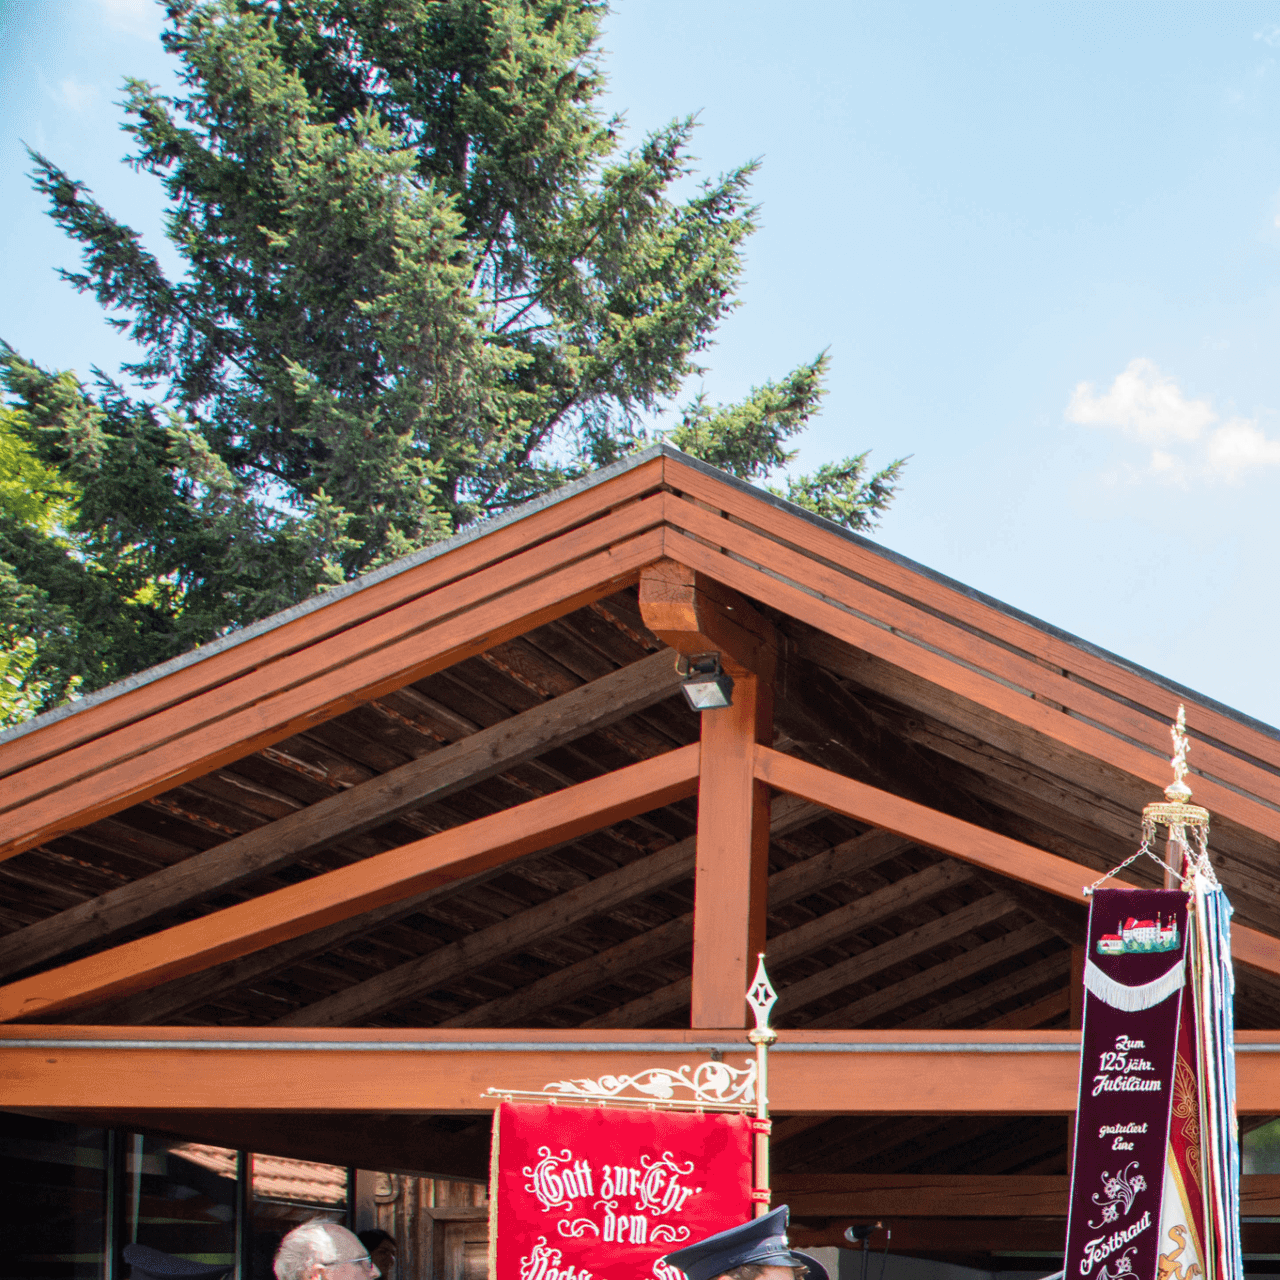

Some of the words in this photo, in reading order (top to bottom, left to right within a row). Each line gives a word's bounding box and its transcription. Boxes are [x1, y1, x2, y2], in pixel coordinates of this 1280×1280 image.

[1115, 1035, 1146, 1051] Zum
[1099, 1052, 1128, 1072] 125
[1124, 1059, 1155, 1074] jähr.
[1091, 1075, 1162, 1097] Jubiläum
[1098, 1122, 1149, 1138] gratuliert
[1111, 1136, 1135, 1151] Eure
[523, 1146, 595, 1212] Gott
[601, 1165, 641, 1200] zur
[595, 1200, 647, 1245] dem
[1079, 1210, 1152, 1276] Festbraut
